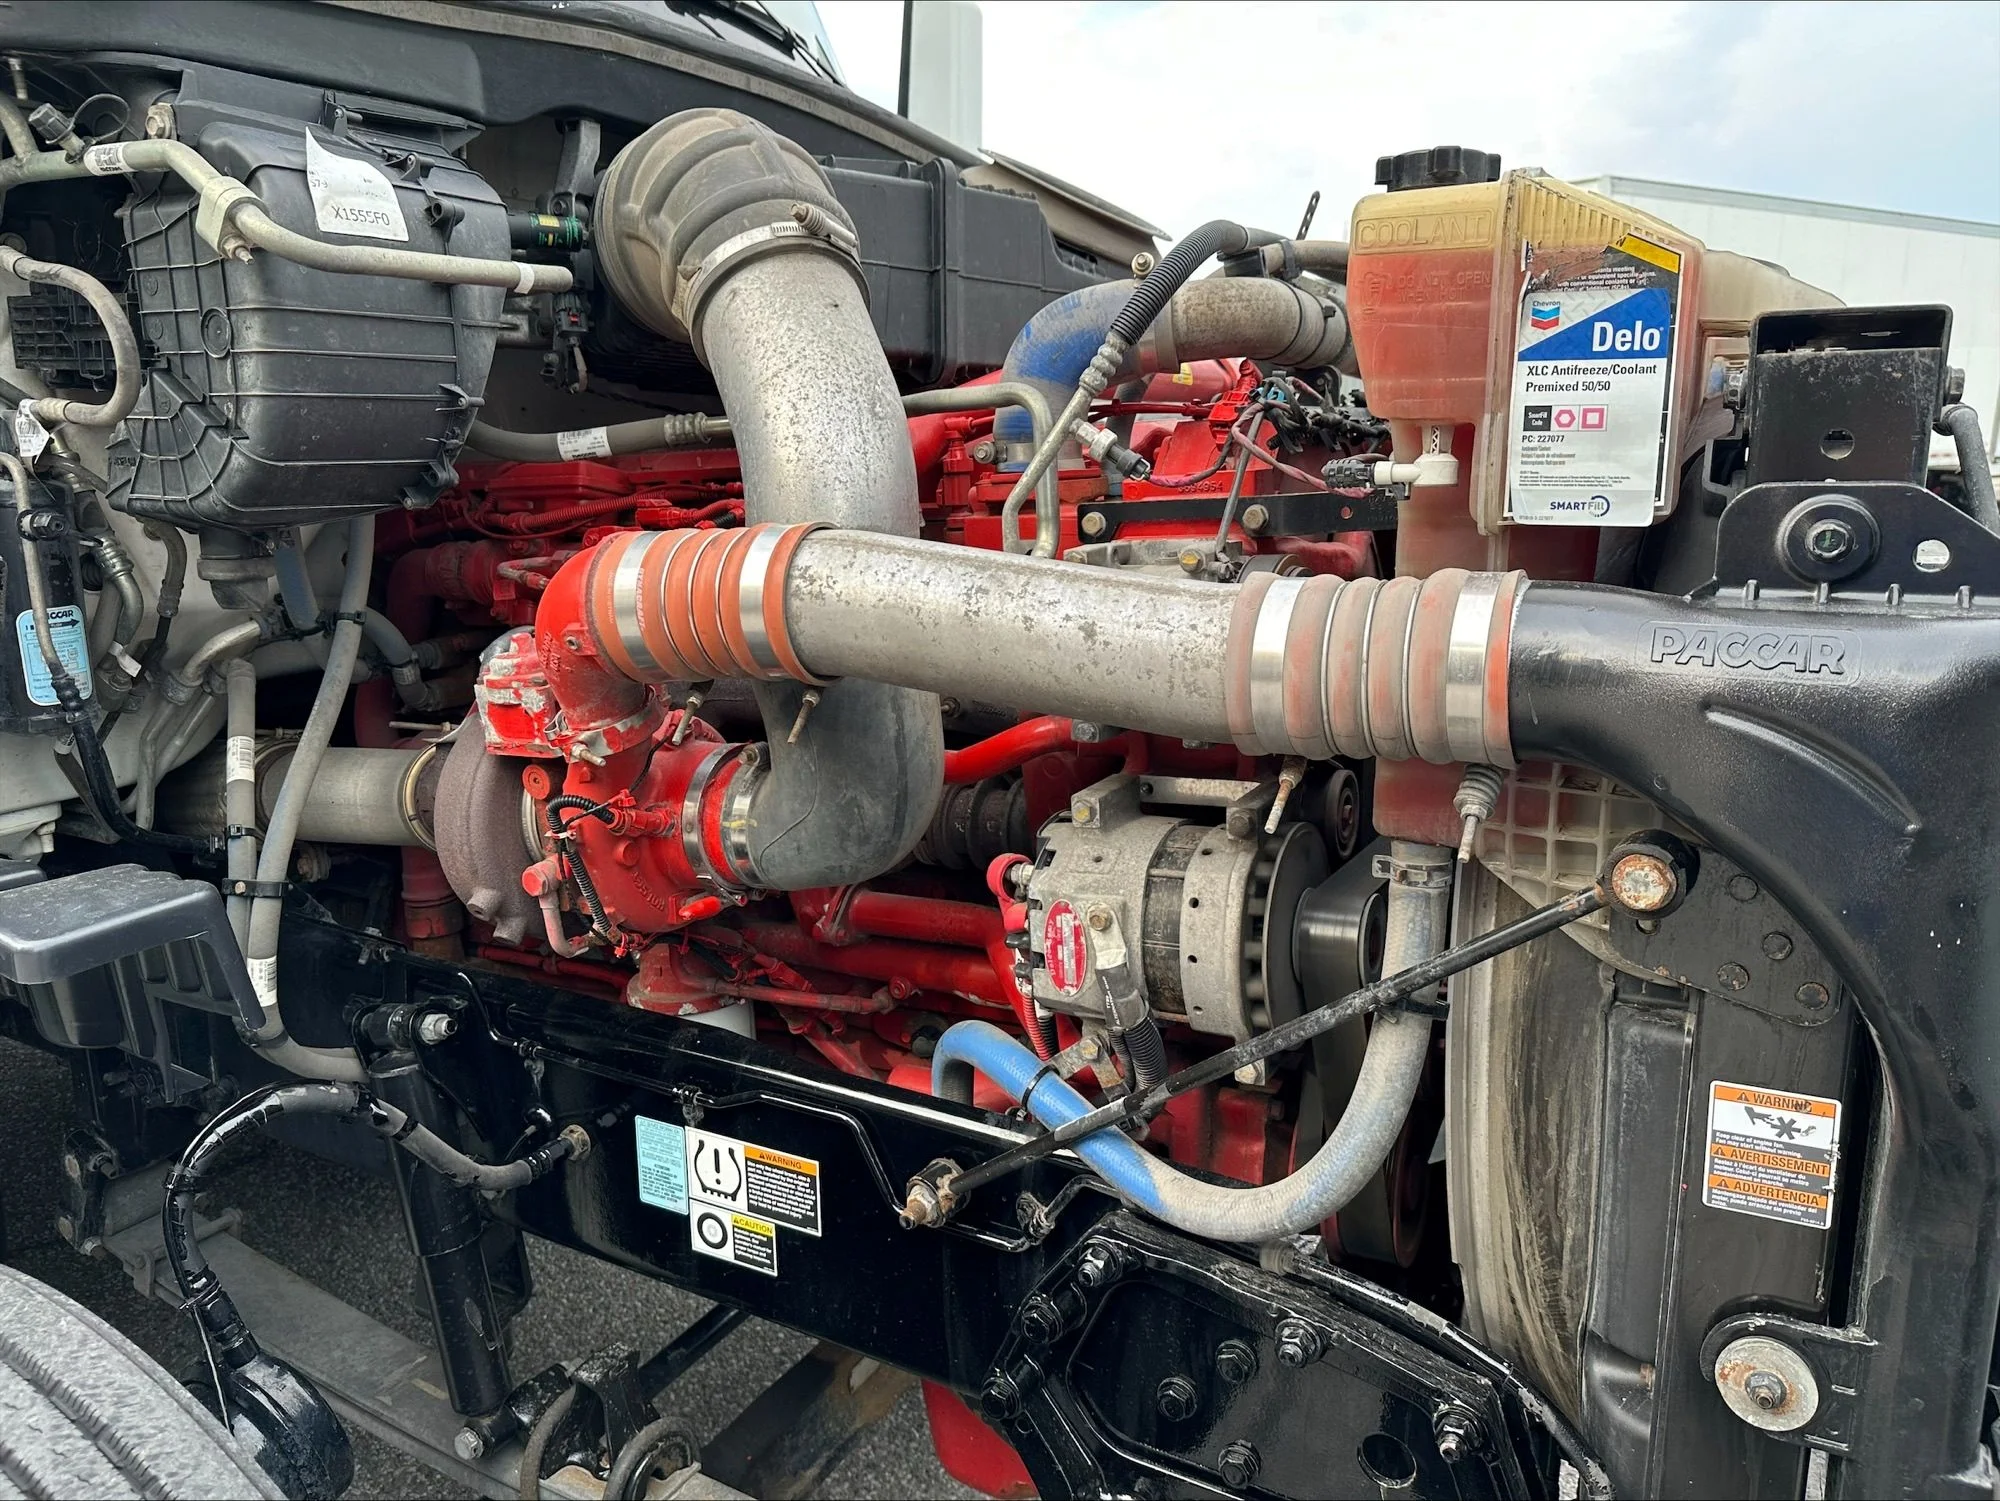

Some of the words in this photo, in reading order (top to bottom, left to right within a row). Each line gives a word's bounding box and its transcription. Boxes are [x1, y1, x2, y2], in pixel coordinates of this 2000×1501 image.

[1359, 214, 1489, 248] COOLANT
[1456, 270, 1491, 286] OPEN
[1592, 320, 1661, 352] Delo
[1526, 365, 1548, 376] XLC
[1551, 364, 1657, 376] Antifreeze/Coolant
[1525, 381, 1579, 392] Premixed
[1582, 381, 1610, 392] 50/50
[1521, 435, 1536, 443] PC:
[1537, 435, 1565, 443] 227077
[48, 609, 74, 620] CCAR
[1651, 627, 1845, 675] PACCAR
[1715, 1131, 1729, 1139] Keep
[1753, 1139, 1772, 1147] engine
[1754, 1144, 1776, 1153] without
[1777, 1148, 1802, 1159] warning.
[764, 1153, 801, 1169] WARNING
[1730, 1148, 1827, 1175] AVERTISSEMENT
[1734, 1180, 1818, 1206] ADVERTENCIA
[739, 1218, 772, 1234] CAUTION
